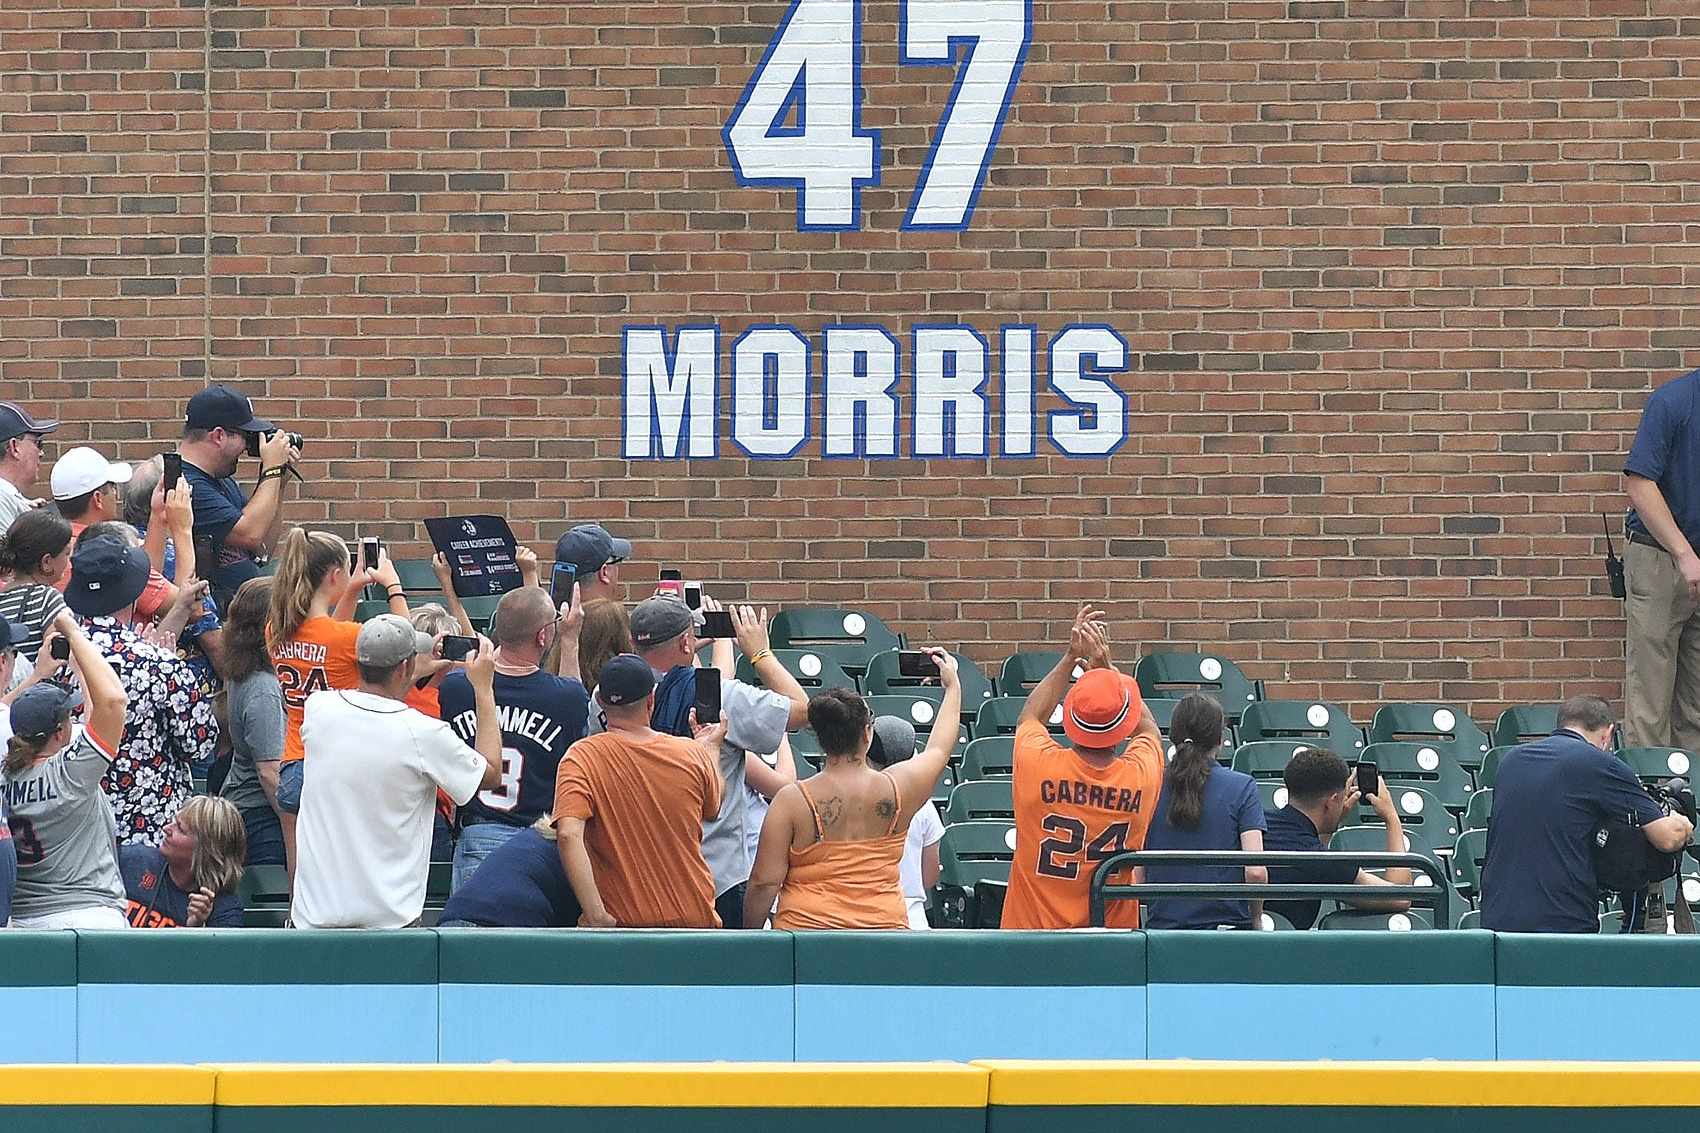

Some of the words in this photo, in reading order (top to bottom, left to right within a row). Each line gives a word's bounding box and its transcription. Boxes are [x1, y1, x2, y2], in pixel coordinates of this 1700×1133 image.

[622, 324, 1129, 460] MORRIS
[453, 705, 562, 752] TRMMELL
[477, 746, 526, 812] 3
[1041, 779, 1142, 814] CABRERA
[1036, 812, 1132, 880] 24
